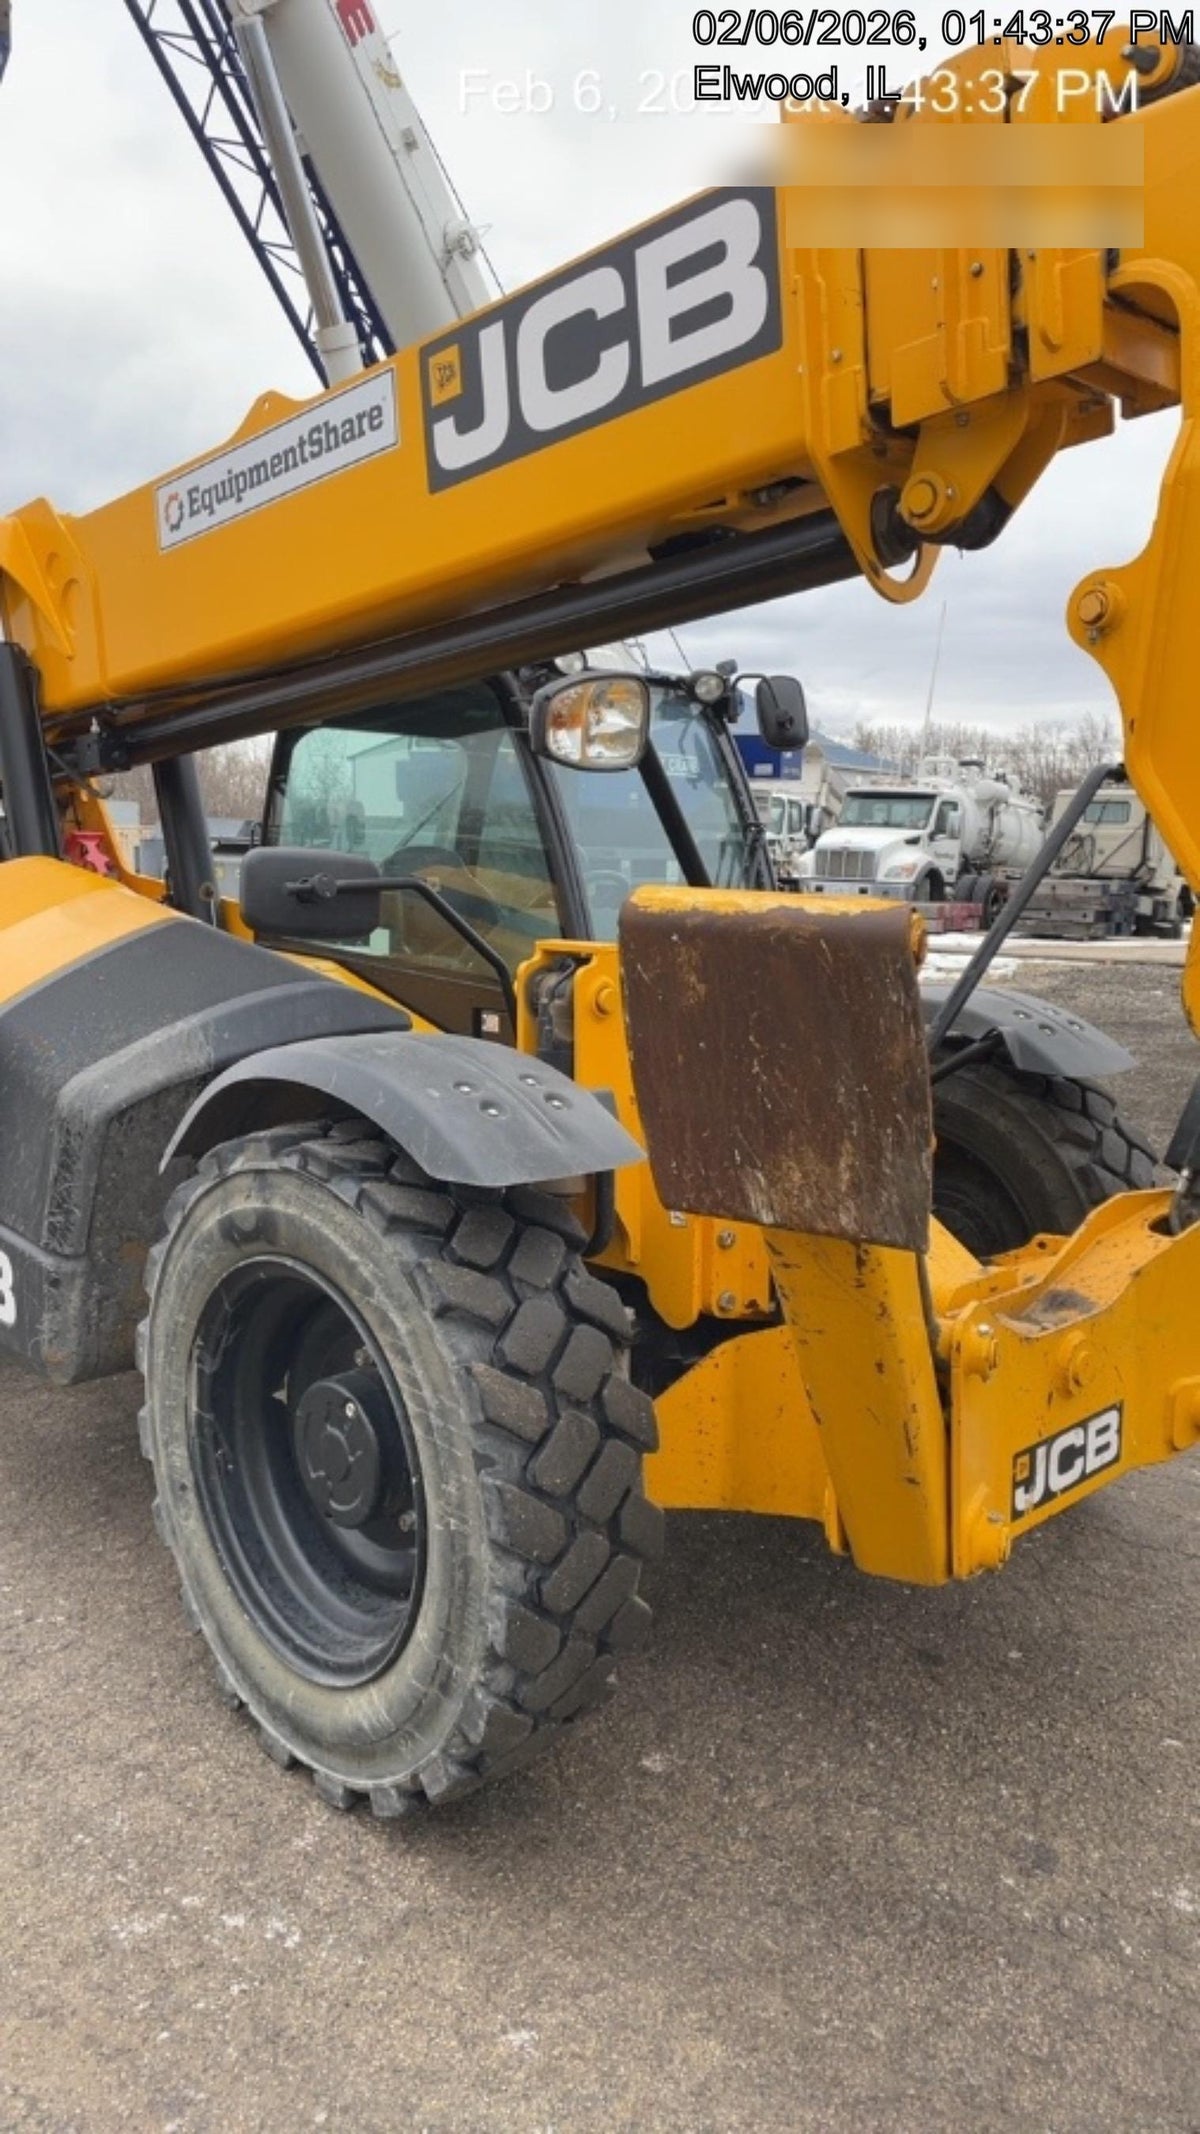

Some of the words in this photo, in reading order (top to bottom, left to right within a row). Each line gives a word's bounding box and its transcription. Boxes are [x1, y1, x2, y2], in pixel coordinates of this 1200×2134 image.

[432, 198, 768, 471] JCB
[187, 403, 384, 518] EquipmentShare
[1014, 1408, 1120, 1512] JCB
